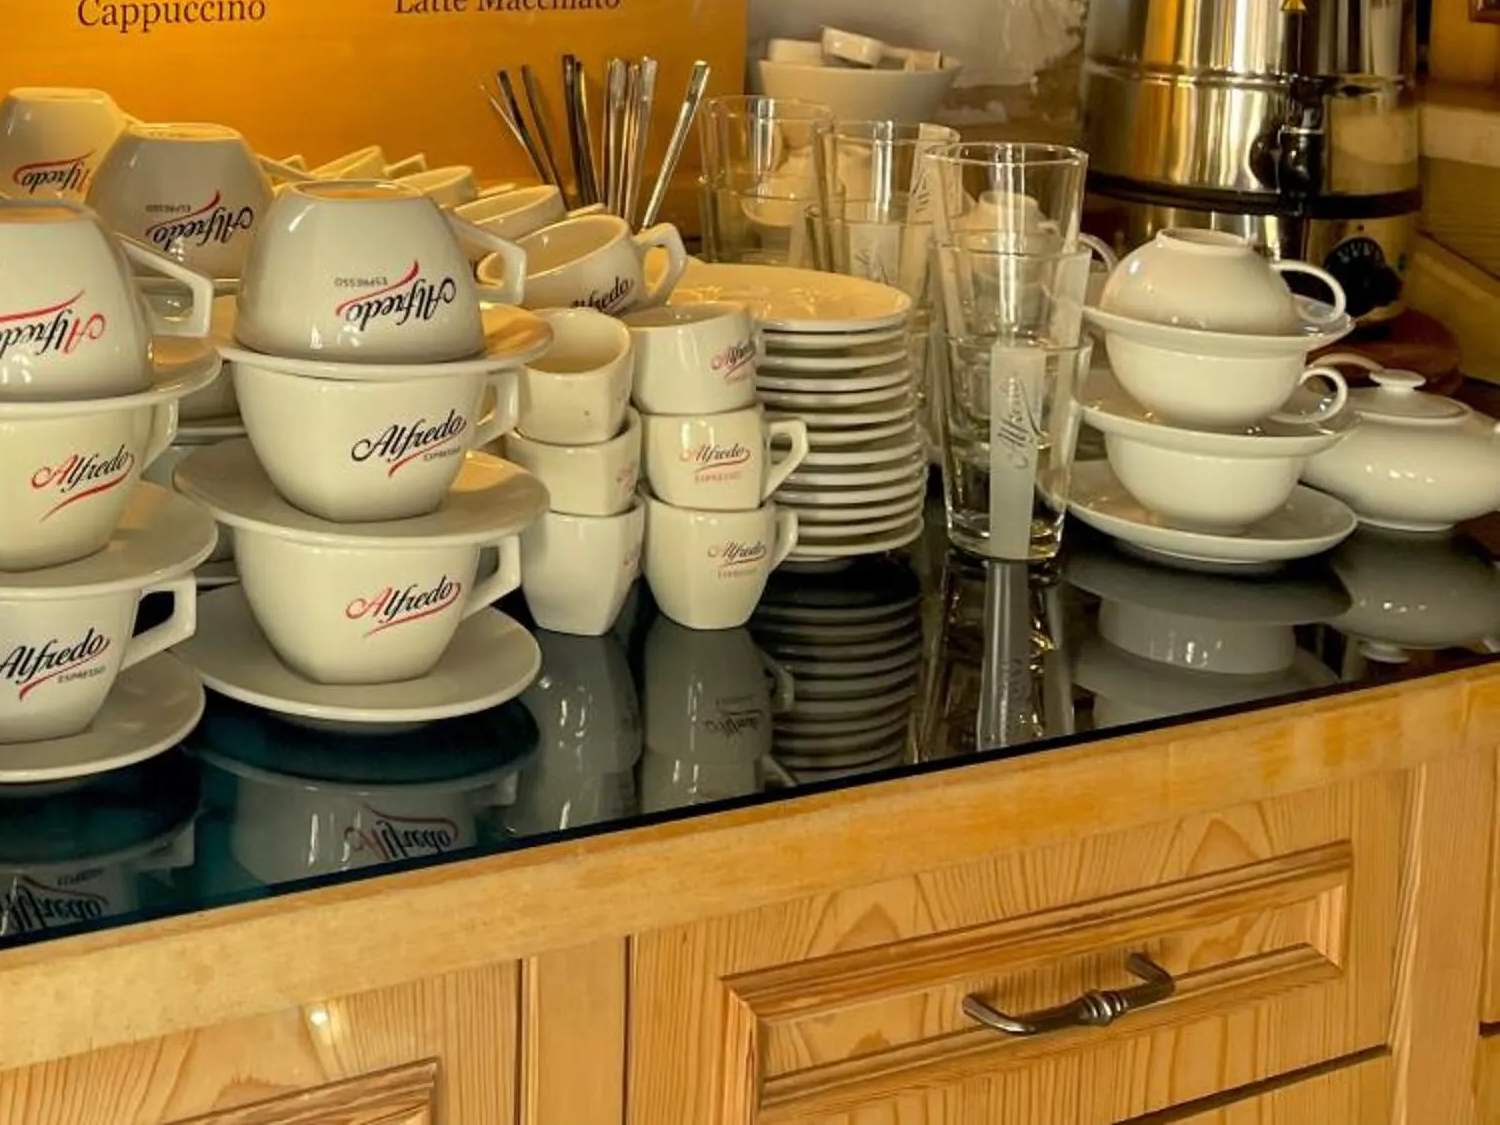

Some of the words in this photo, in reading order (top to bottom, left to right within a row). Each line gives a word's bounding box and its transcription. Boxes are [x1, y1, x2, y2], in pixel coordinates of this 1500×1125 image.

[153, 206, 254, 252] Alfredo
[345, 276, 457, 332] Alfredo
[351, 408, 464, 463] Alfredo
[680, 442, 747, 463] Alfredo
[30, 443, 132, 493] Alfredo
[707, 540, 763, 565] Alfredo
[345, 574, 455, 624] Alfredo
